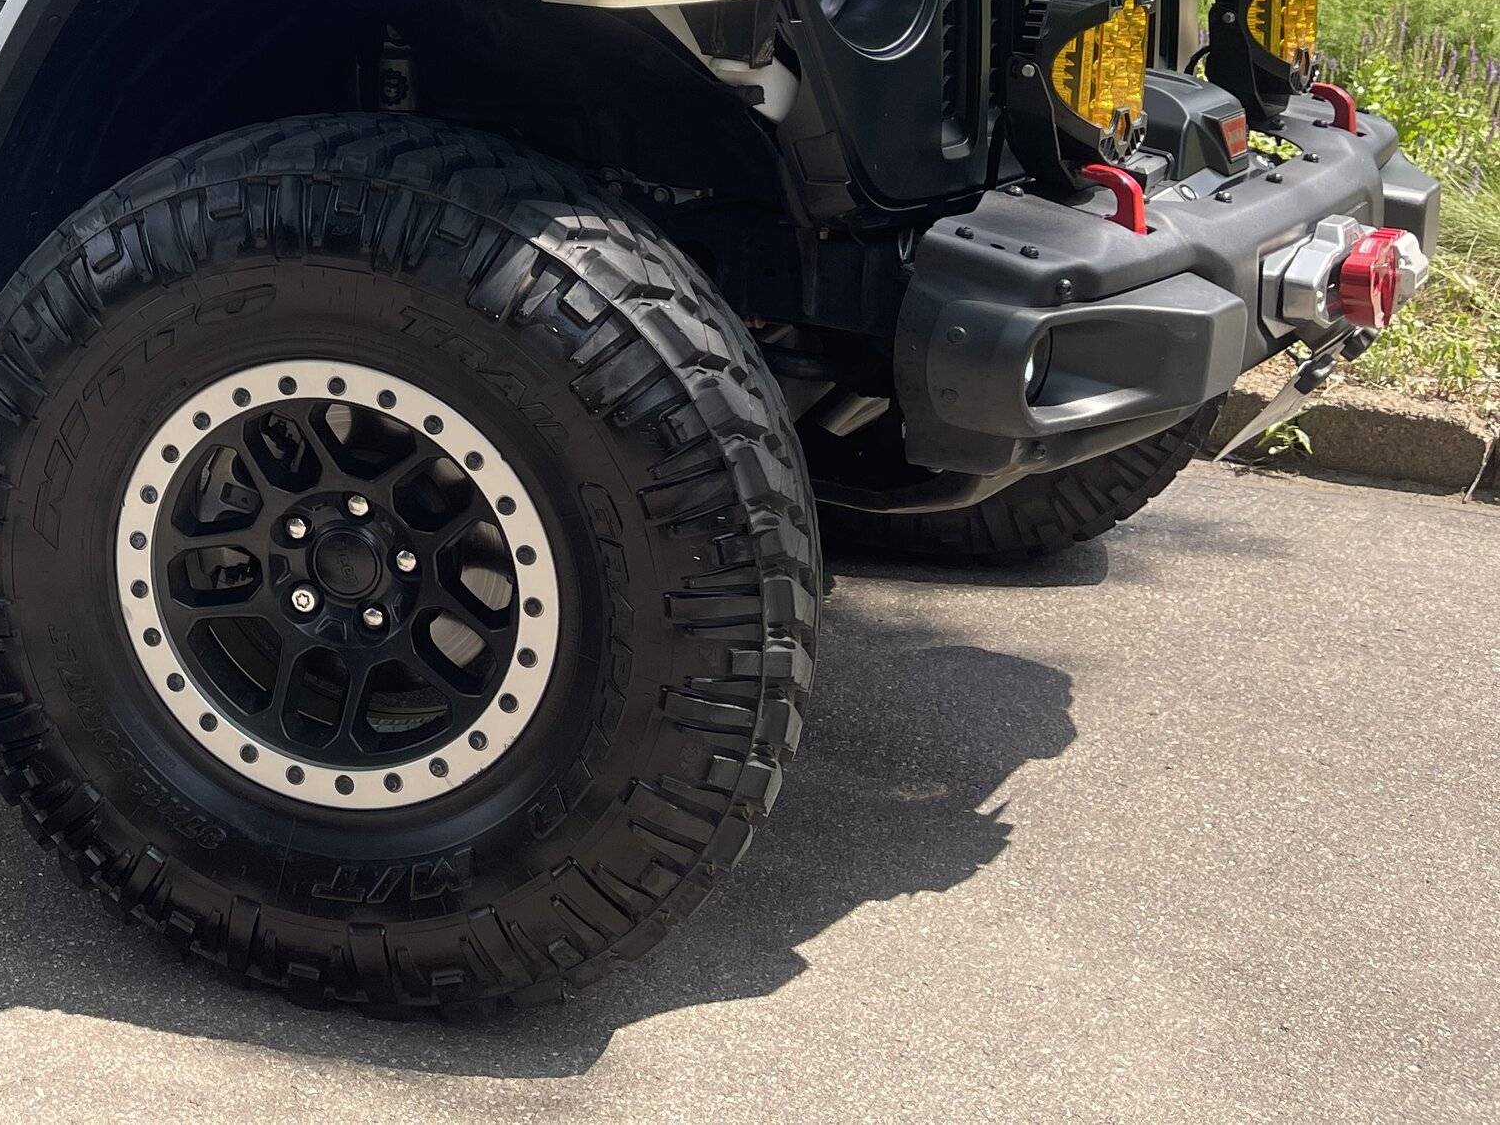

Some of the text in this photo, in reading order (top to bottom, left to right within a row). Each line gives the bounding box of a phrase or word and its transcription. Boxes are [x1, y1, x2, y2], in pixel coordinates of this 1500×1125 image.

[33, 282, 276, 550] NITTO
[399, 304, 571, 457] TRAIL
[311, 844, 477, 906] M/T
